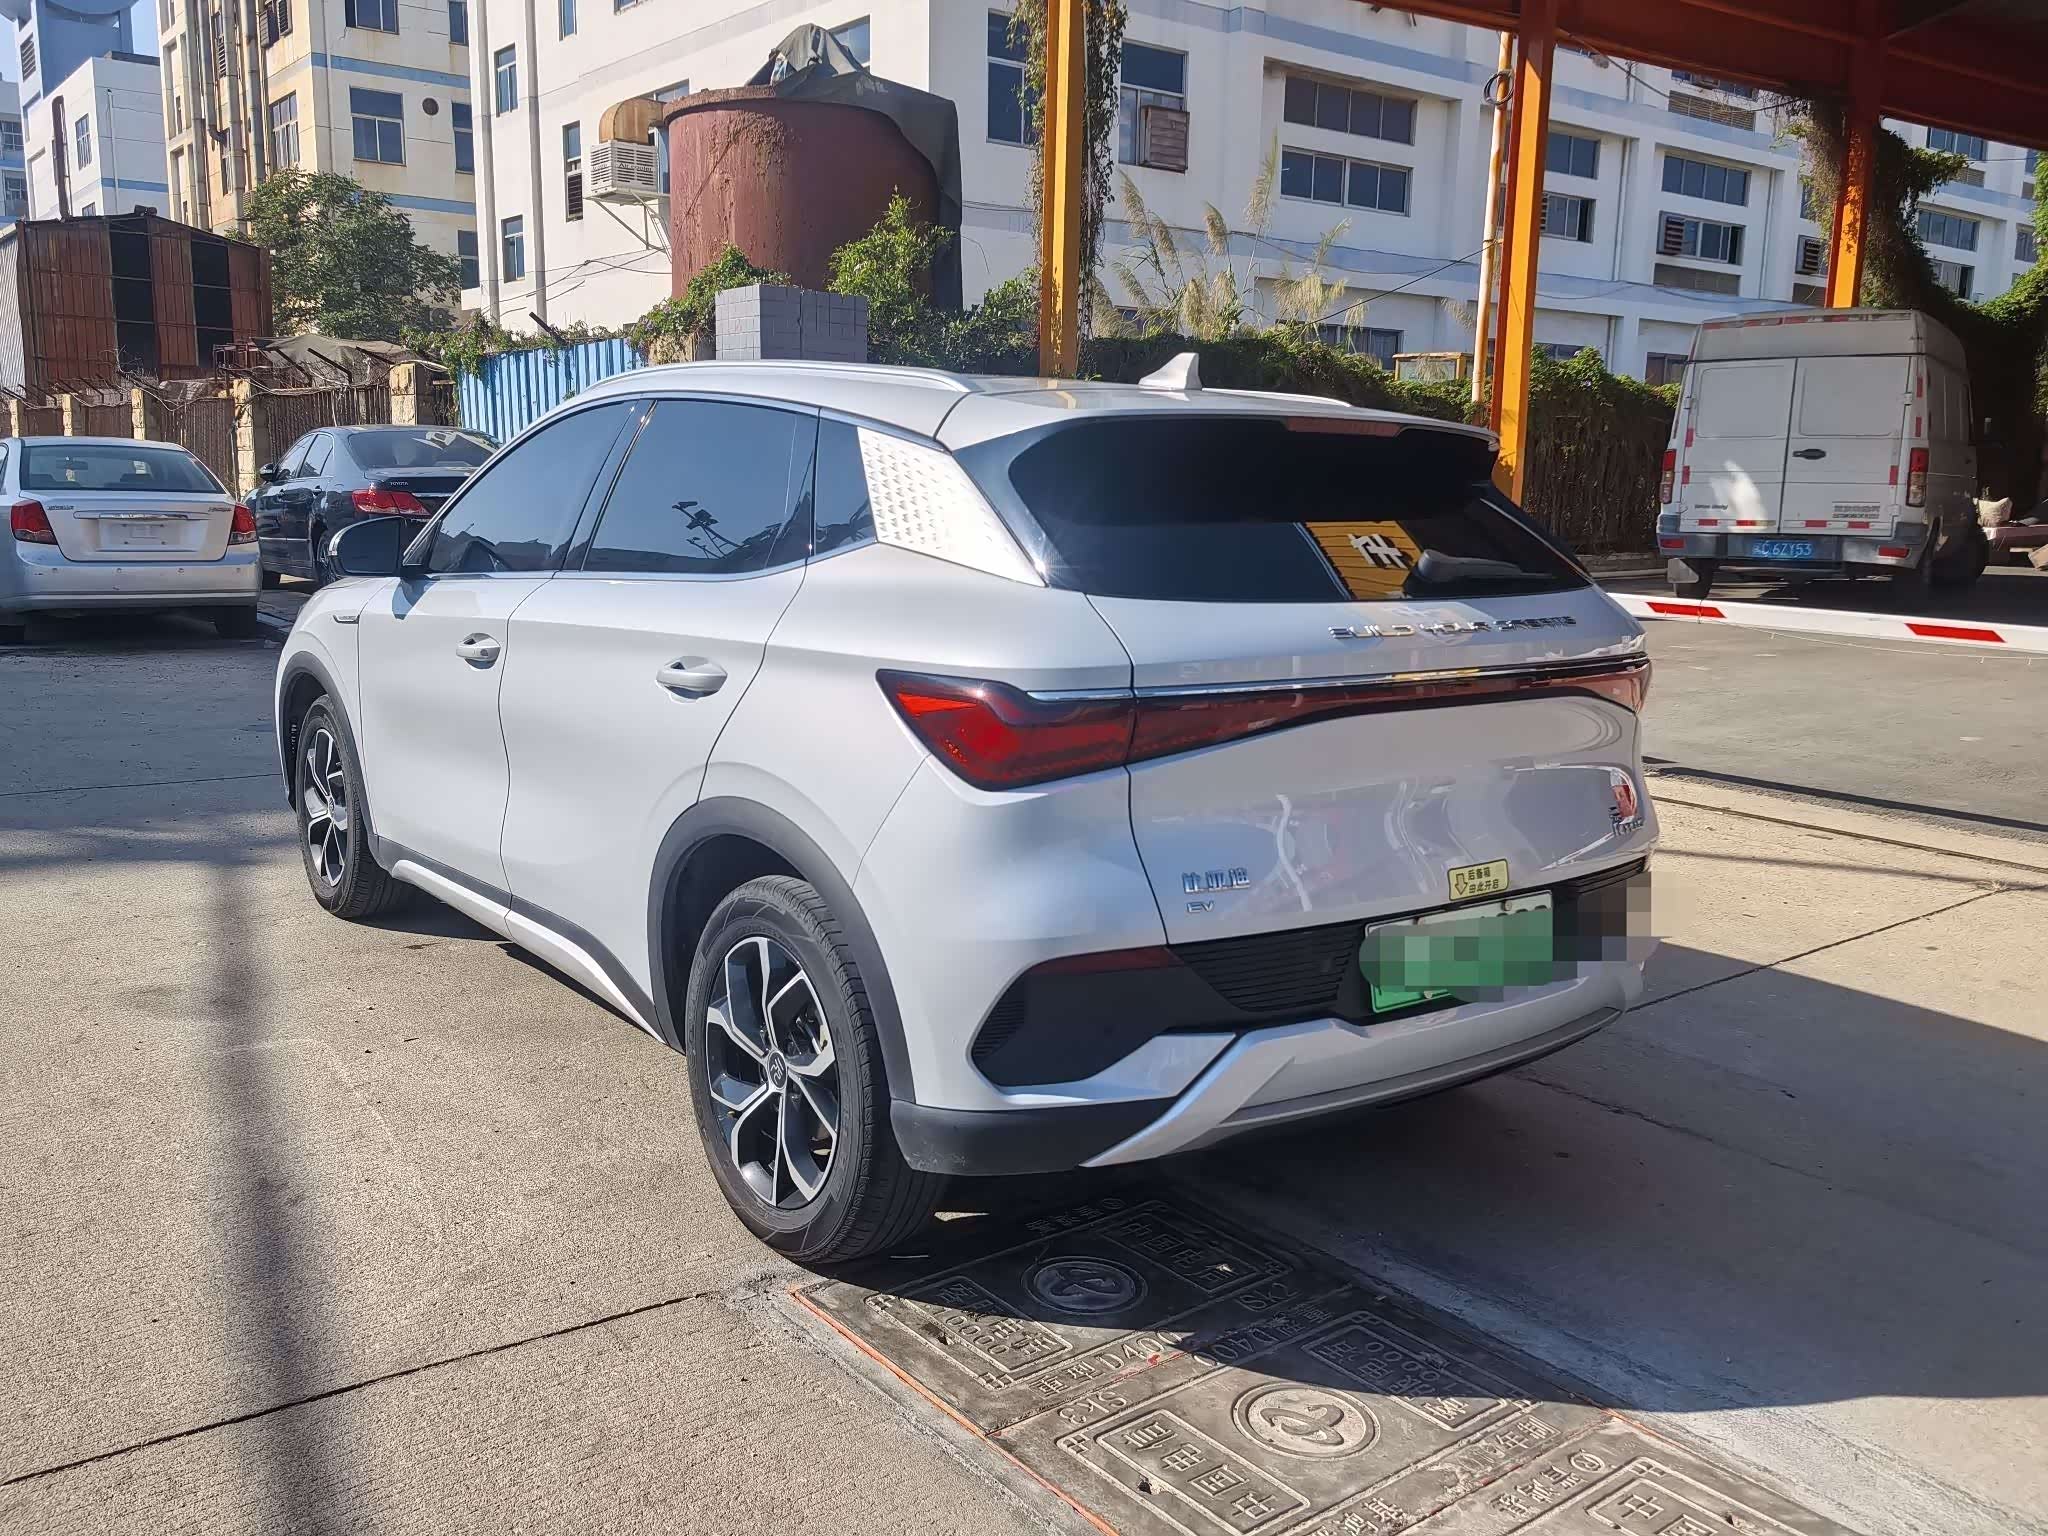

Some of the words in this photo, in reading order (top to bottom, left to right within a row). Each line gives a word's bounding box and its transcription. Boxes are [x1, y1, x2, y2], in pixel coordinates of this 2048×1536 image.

[1328, 624, 1415, 640] BUILD
[1419, 621, 1492, 636] YOUR
[1186, 900, 1215, 913] EV
[1122, 1222, 1238, 1283] 中国电信
[933, 1306, 1009, 1355] 10000
[1058, 1391, 1127, 1425] SK3
[1121, 1419, 1274, 1521] 中国电信
